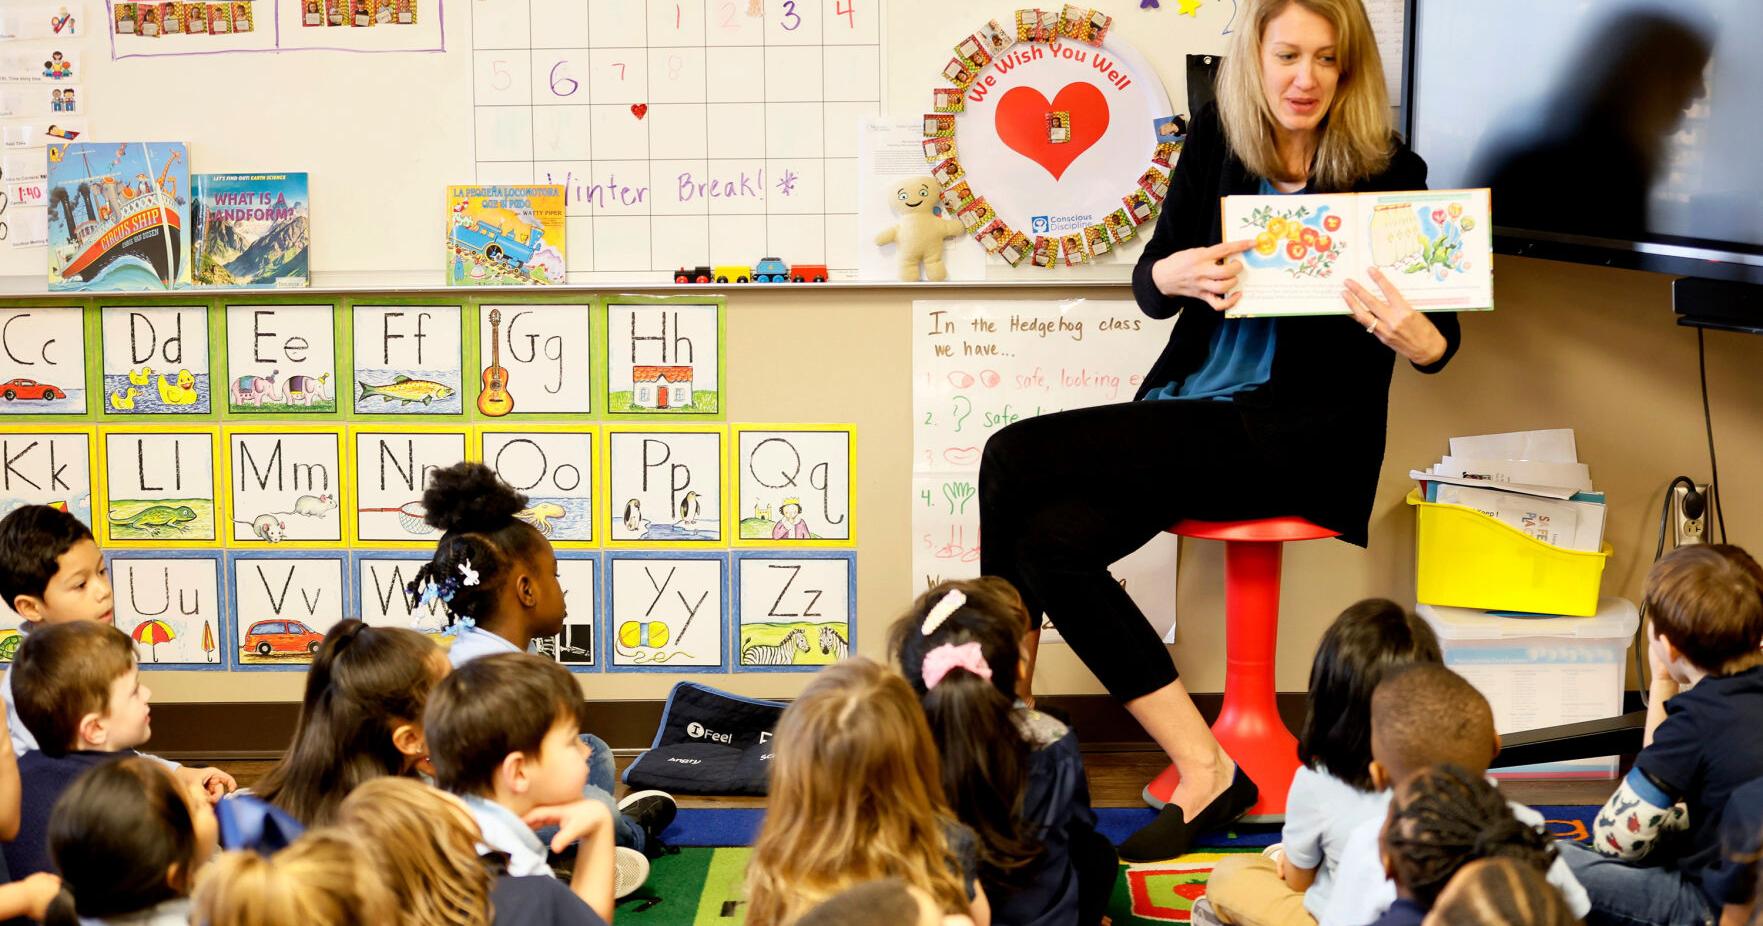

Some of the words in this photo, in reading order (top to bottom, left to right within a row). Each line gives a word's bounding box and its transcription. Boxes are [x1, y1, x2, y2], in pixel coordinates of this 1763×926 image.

[720, 1, 741, 28] 2
[780, 0, 801, 31] 3
[835, 0, 855, 29] 4
[490, 60, 512, 91] 5
[549, 60, 579, 97] 6
[612, 63, 626, 81] 7
[967, 74, 997, 103] We
[993, 44, 1044, 75] Wish
[1049, 42, 1087, 63] You
[1091, 53, 1132, 92] Well
[18, 186, 41, 201] 1:40
[213, 191, 255, 206] WHAT
[259, 191, 272, 205] IS
[277, 191, 287, 205] A
[453, 187, 464, 198] LA
[677, 168, 765, 202] Break!
[101, 221, 131, 251] CIRCUS
[132, 209, 159, 233] SHIP
[1050, 214, 1093, 224] Conscious
[2, 313, 57, 366] Cc
[129, 312, 182, 365] Dd
[254, 310, 309, 364] Ee
[383, 312, 431, 365] Ff
[631, 311, 694, 364] Hh
[928, 310, 955, 336] In
[971, 317, 997, 334] the
[1010, 314, 1083, 341] Hedgehog
[1098, 314, 1142, 332] class
[507, 311, 563, 394] Gg
[934, 344, 954, 358] we
[963, 341, 1016, 358] have...
[1015, 367, 1050, 392] safe,
[1059, 368, 1121, 399] looking
[924, 411, 937, 427] 2.
[983, 403, 1019, 429] safe
[3, 439, 70, 492] Kk
[240, 439, 328, 492] Mm
[495, 438, 581, 491] Oo
[642, 438, 692, 519] Pp
[749, 437, 844, 525] Qq
[130, 566, 200, 617] Uu
[257, 565, 321, 616] Vv
[645, 565, 709, 647] Yy
[768, 564, 823, 618] Zz
[704, 728, 733, 744] Feel
